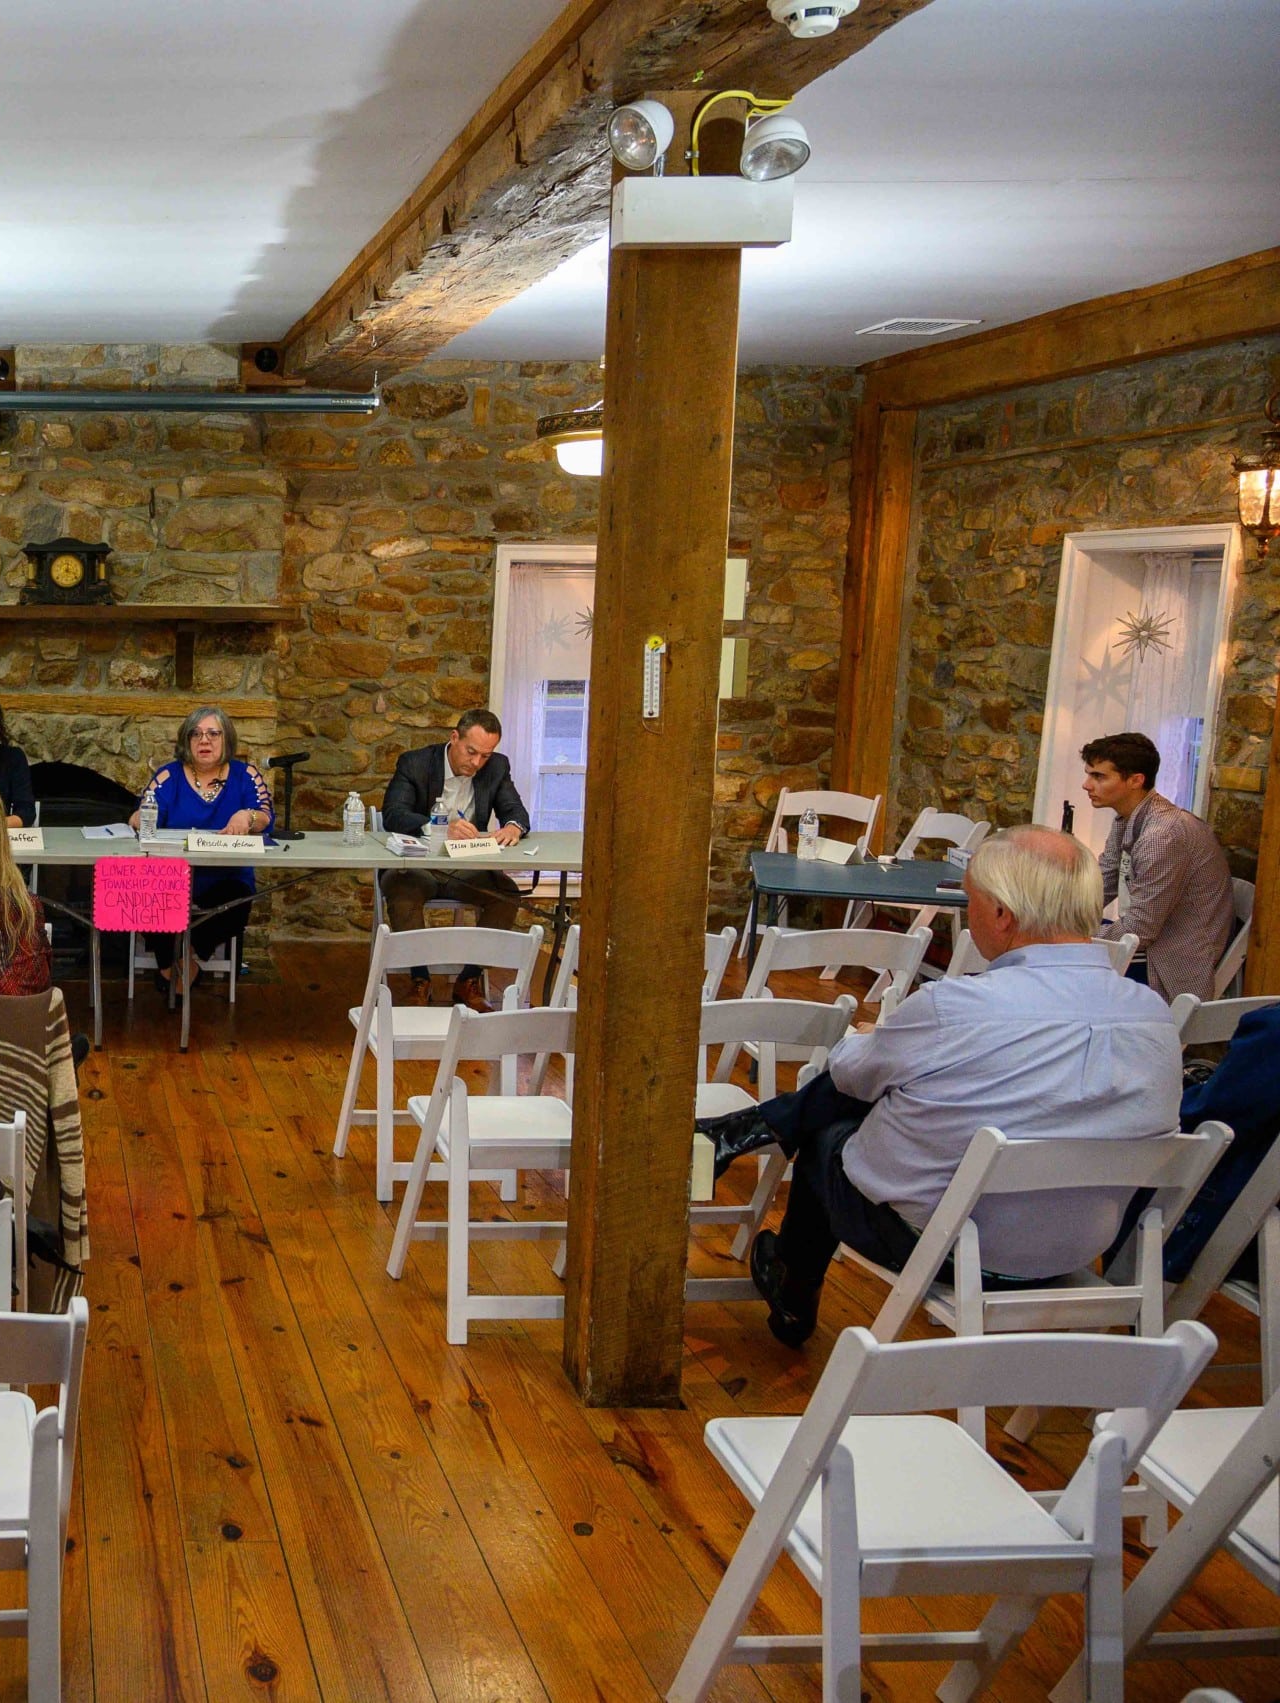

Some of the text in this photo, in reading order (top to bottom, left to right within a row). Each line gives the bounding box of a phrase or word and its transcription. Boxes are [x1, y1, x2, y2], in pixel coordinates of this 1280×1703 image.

[101, 864, 183, 877] LOWER SAUCON
[101, 879, 188, 891] TOWNSHIP COUNCIL
[104, 891, 182, 910] CANDIDATES
[121, 909, 166, 925] NIGHT
